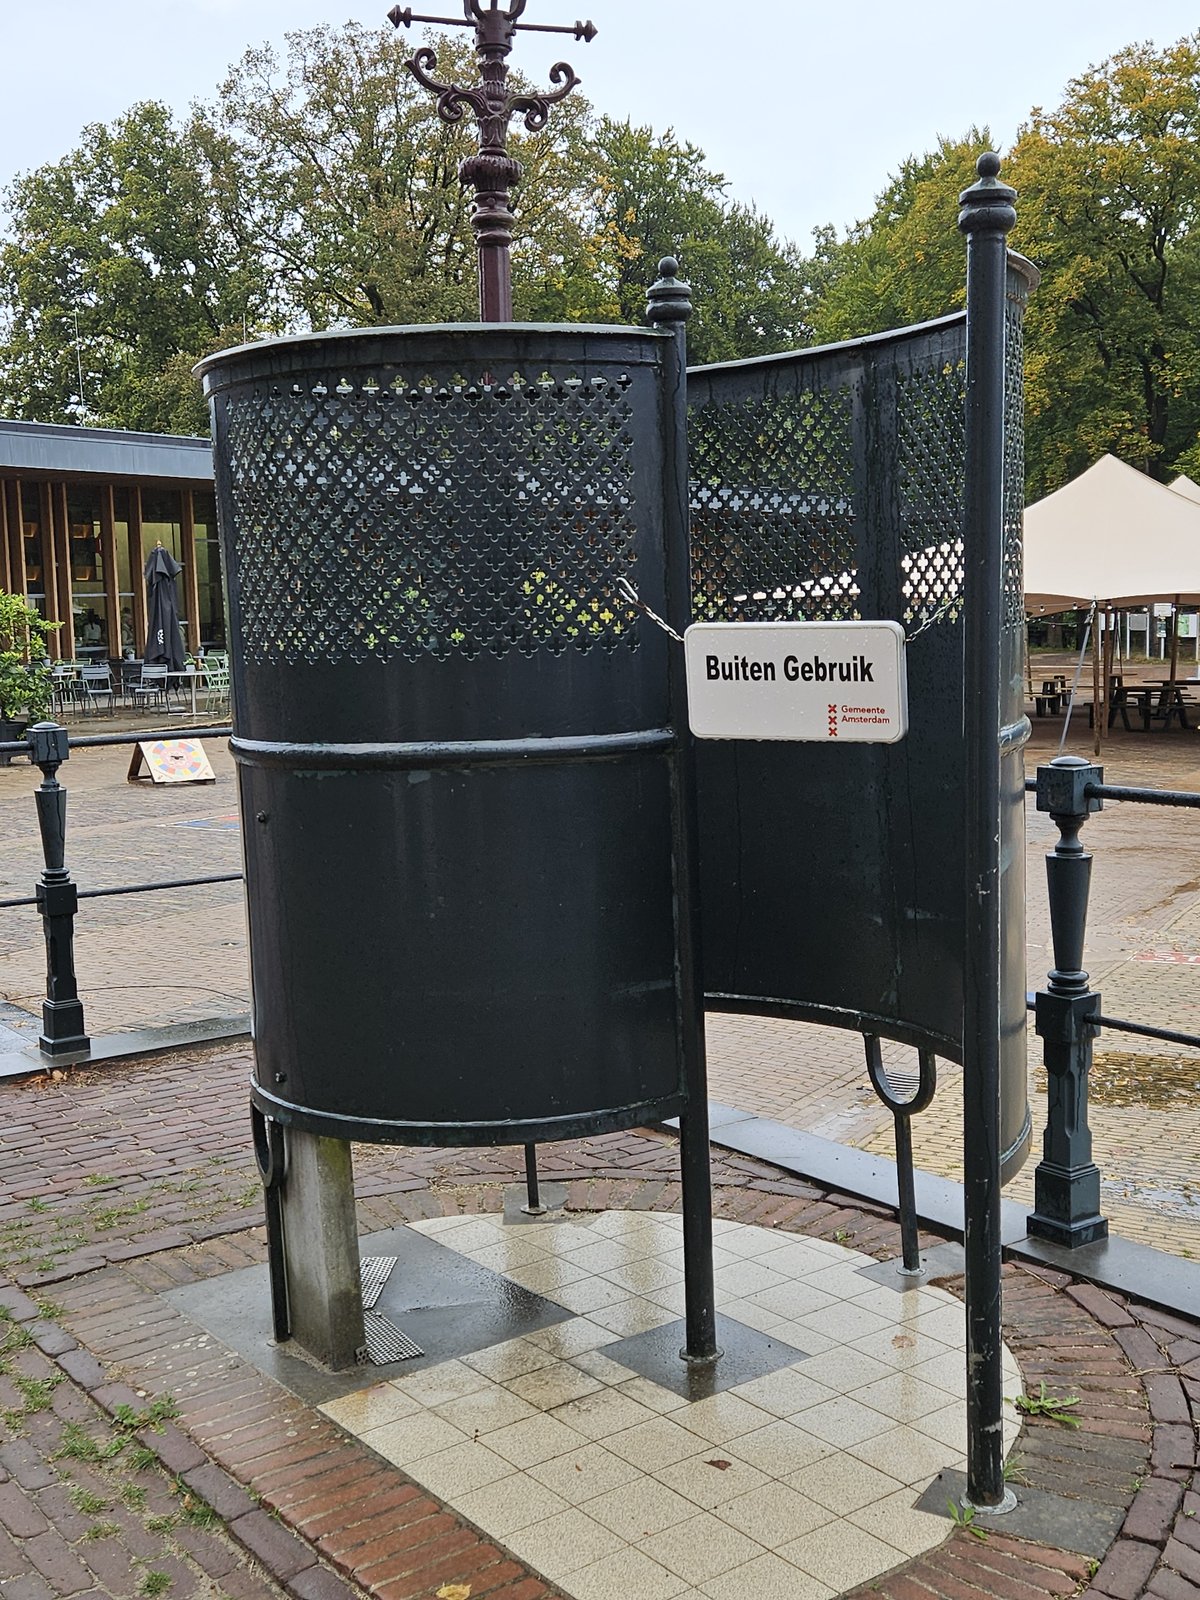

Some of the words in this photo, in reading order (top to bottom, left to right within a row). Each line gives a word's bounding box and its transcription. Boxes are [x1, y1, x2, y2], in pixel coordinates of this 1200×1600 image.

[706, 655, 776, 681] Buiten
[783, 655, 874, 682] Gebruik
[841, 705, 886, 714] Gemeente
[841, 715, 890, 724] Amsterdam
